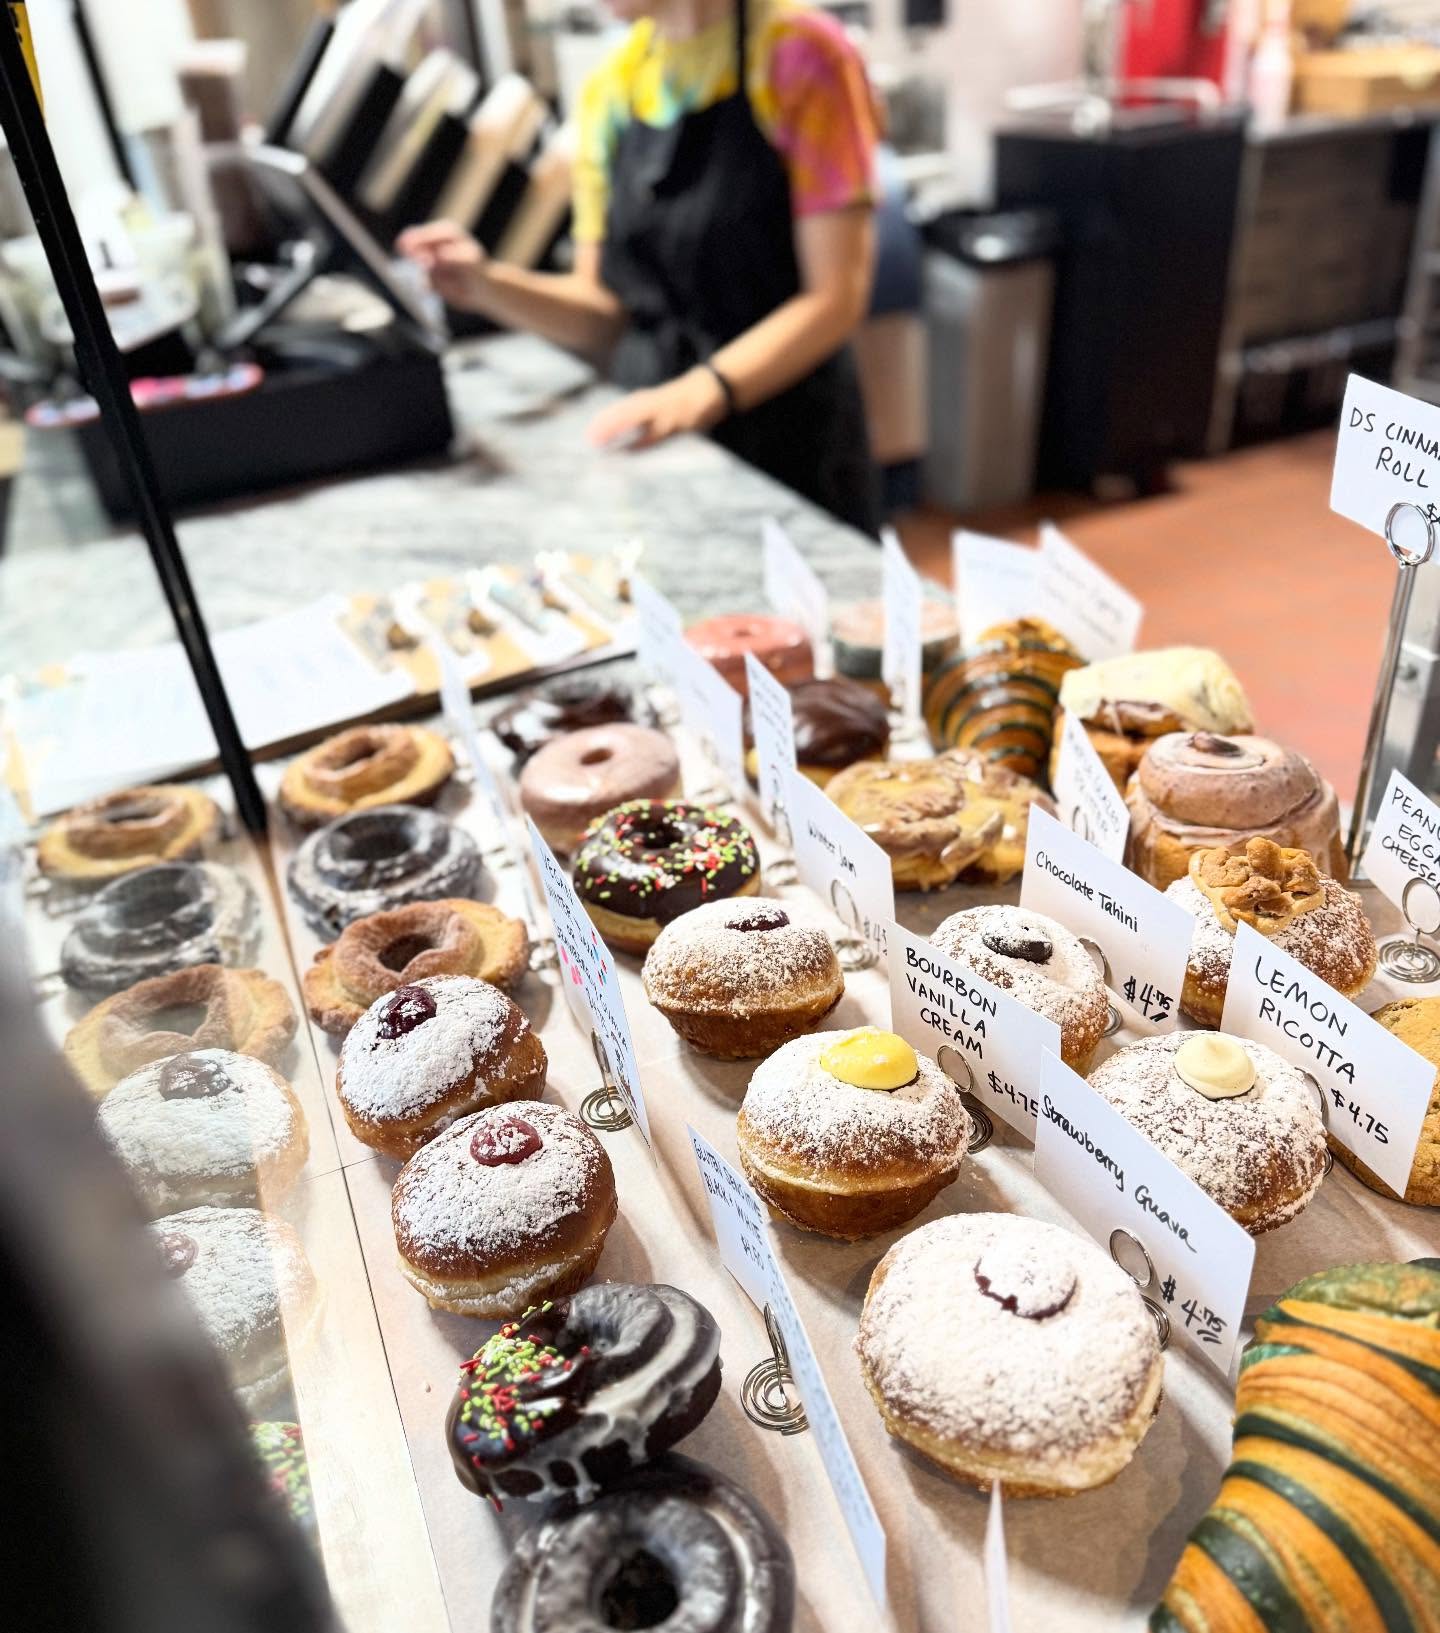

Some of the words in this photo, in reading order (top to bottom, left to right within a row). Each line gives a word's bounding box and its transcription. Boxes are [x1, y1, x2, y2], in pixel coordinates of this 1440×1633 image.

[1350, 407, 1376, 433] DS
[1385, 422, 1440, 461] CINNA
[1376, 446, 1429, 488] ROLL
[1036, 850, 1094, 901] Chocolate
[1098, 890, 1138, 933] Tahini
[905, 947, 997, 1018] BOURBON
[905, 972, 986, 1039] VANILLA
[1254, 955, 1348, 1037] LEMON
[920, 1007, 983, 1060] CREAM
[1258, 997, 1356, 1085] RICOTTA
[1330, 1087, 1389, 1145] $4.75
[1041, 1094, 1124, 1193] Strawberry
[1134, 1184, 1197, 1253] Guava
